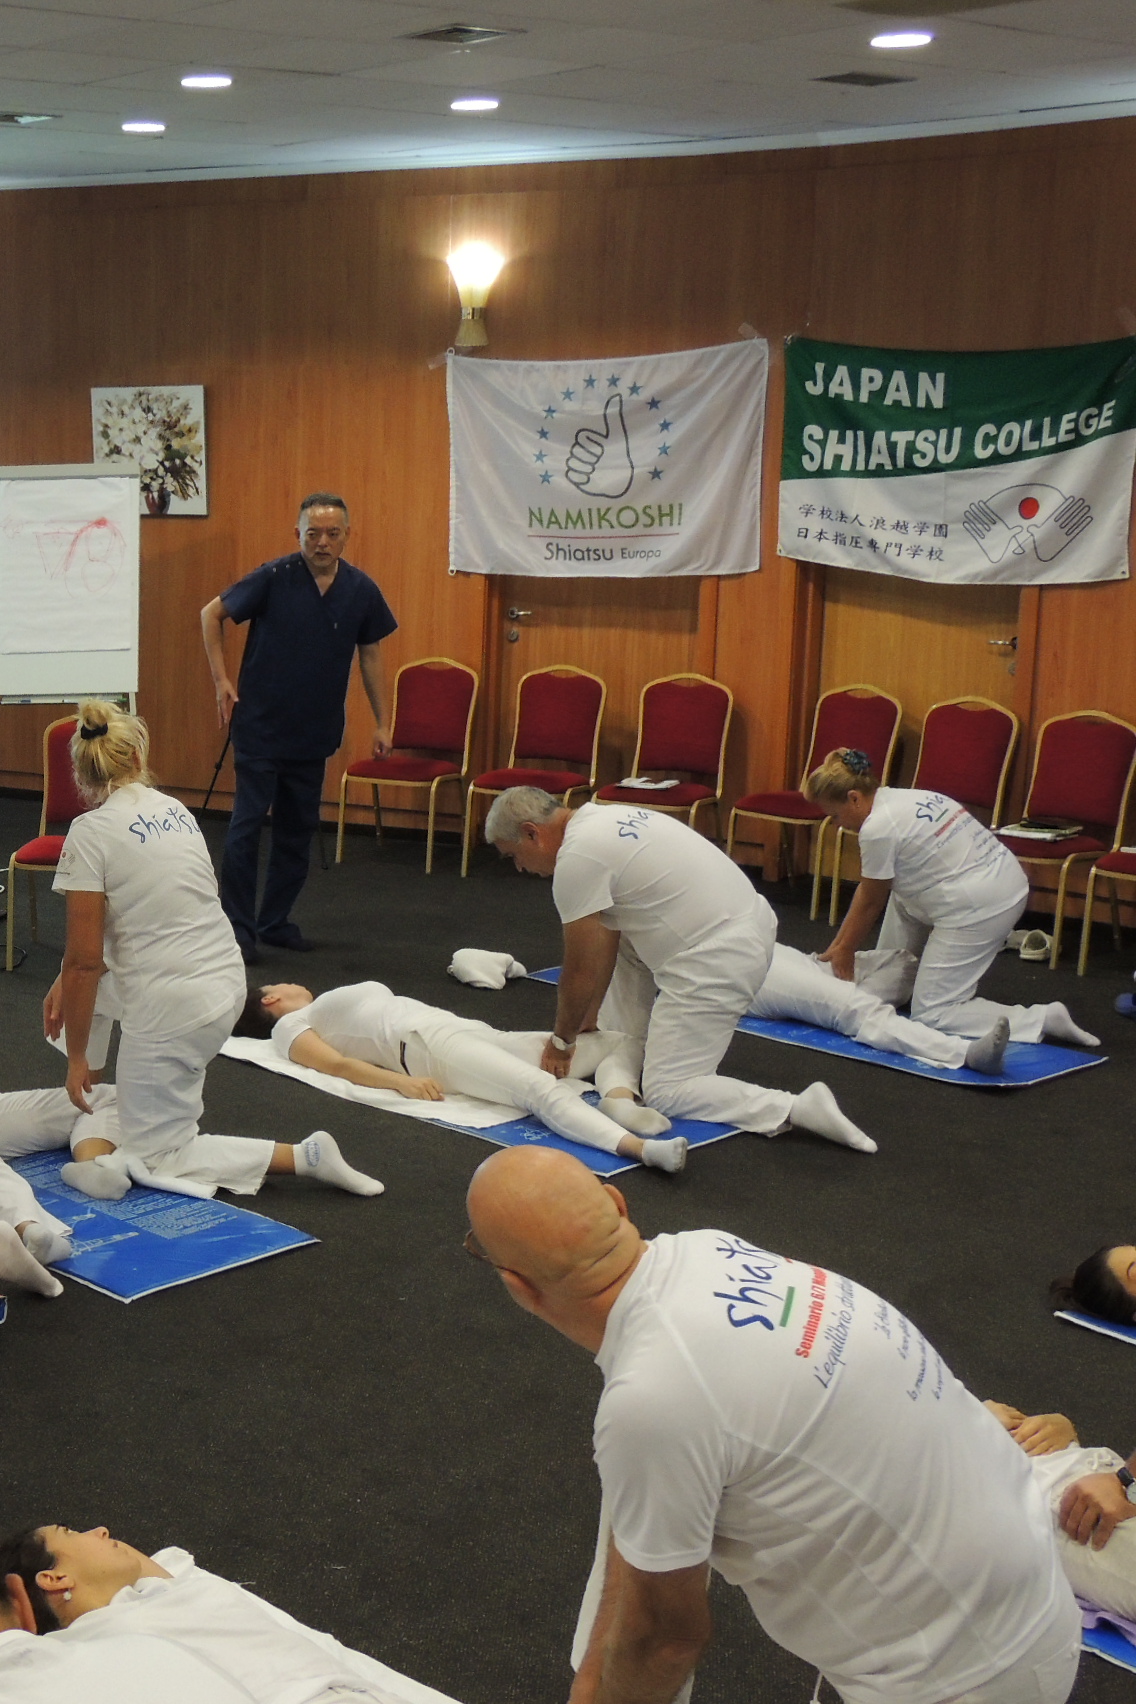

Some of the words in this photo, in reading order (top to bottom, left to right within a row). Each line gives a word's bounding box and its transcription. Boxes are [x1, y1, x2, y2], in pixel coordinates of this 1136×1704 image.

[804, 362, 945, 409] JAPAN
[801, 425, 962, 472] SHIATSU
[974, 399, 1116, 460] COLLEGE
[527, 502, 684, 530] NAMIKOSHI
[544, 542, 614, 562] Shiatsu
[620, 542, 662, 562] Europa
[795, 1300, 825, 1359] Seminario
[813, 1310, 852, 1389] L'equilibrio
